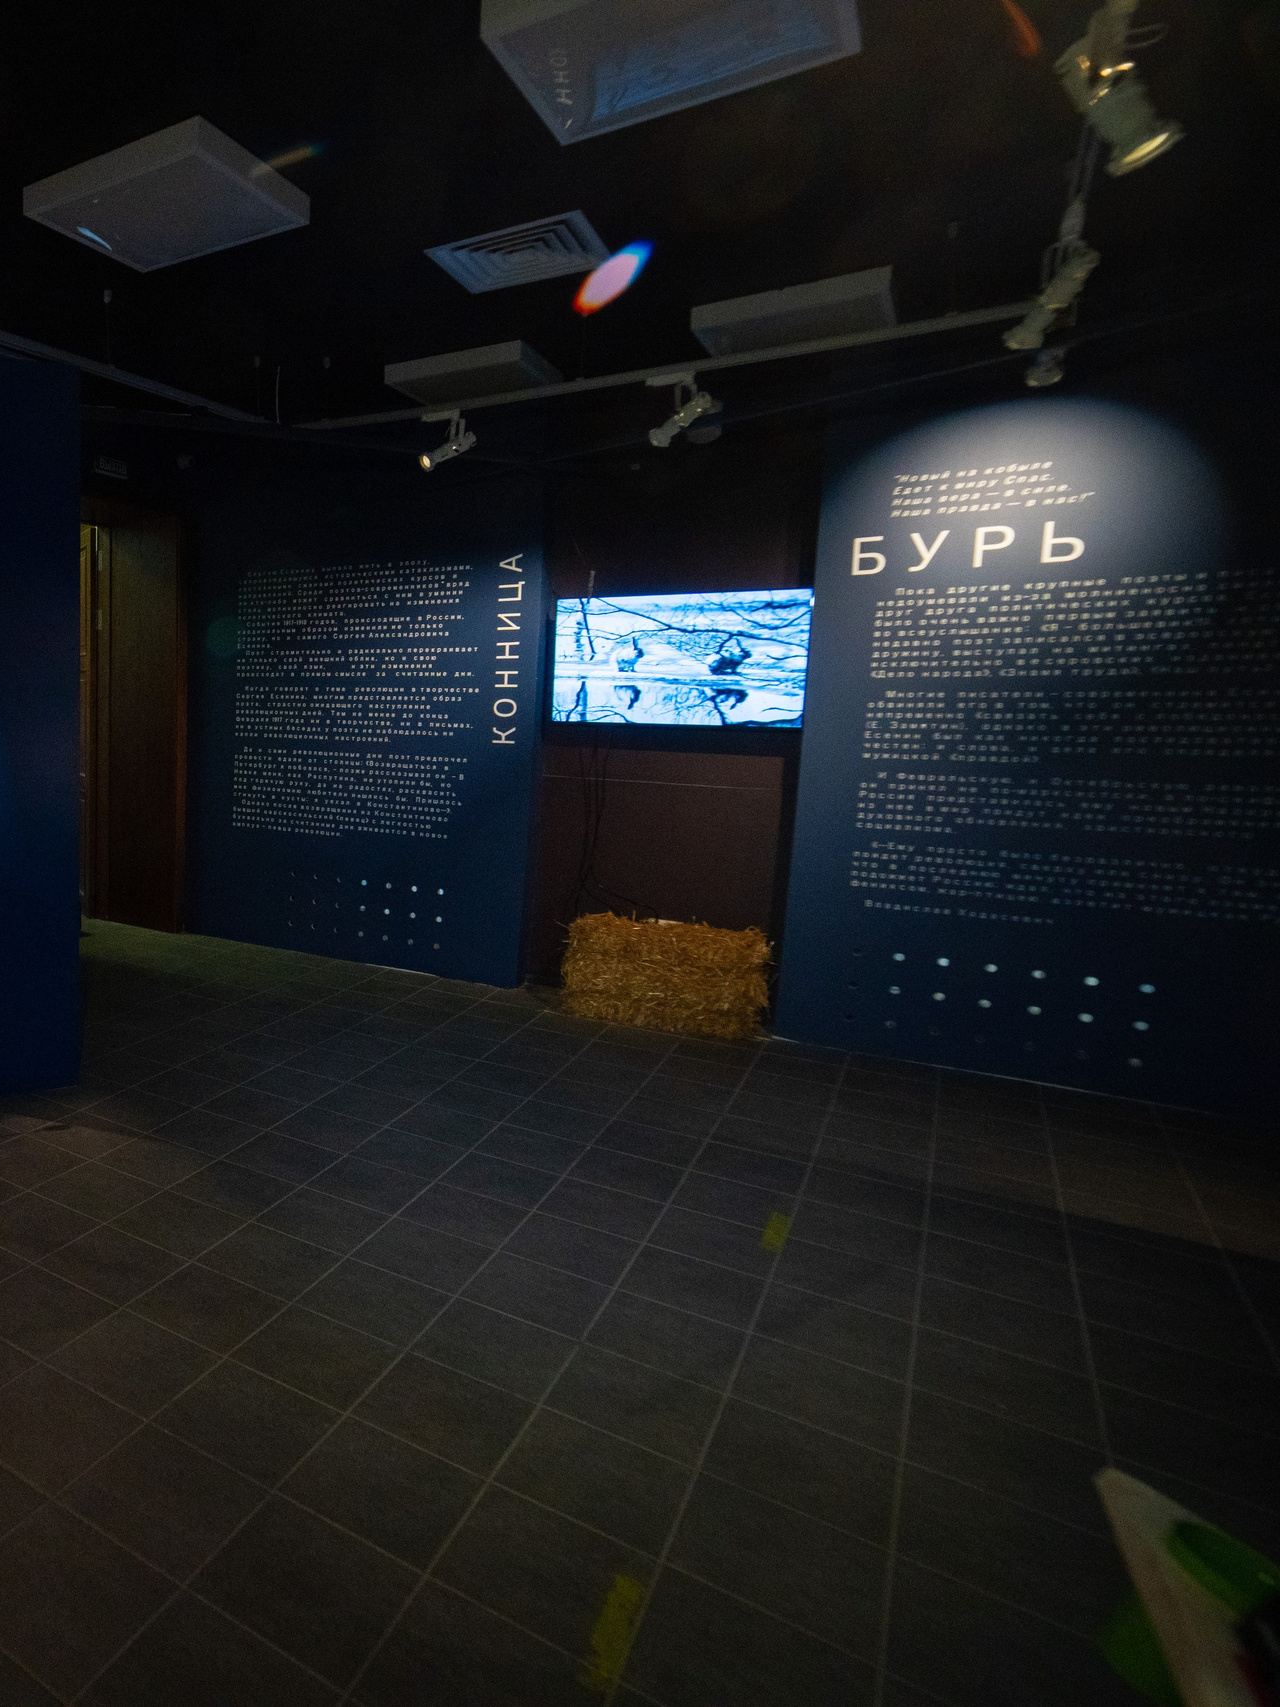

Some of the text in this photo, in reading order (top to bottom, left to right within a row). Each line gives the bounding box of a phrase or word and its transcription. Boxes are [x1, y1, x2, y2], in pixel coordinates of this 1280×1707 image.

[982, 461, 1054, 476] кобыле
[892, 484, 933, 496] Едет
[938, 483, 950, 492] к
[953, 478, 1000, 491] миру
[891, 496, 933, 507] Наша
[937, 492, 981, 504] вера
[1003, 489, 1016, 498] в
[890, 508, 932, 518] Наша
[936, 502, 1002, 515] правда
[1024, 499, 1037, 508] в
[850, 521, 1086, 576] БУРЬ
[491, 553, 524, 745] КОННИЦА
